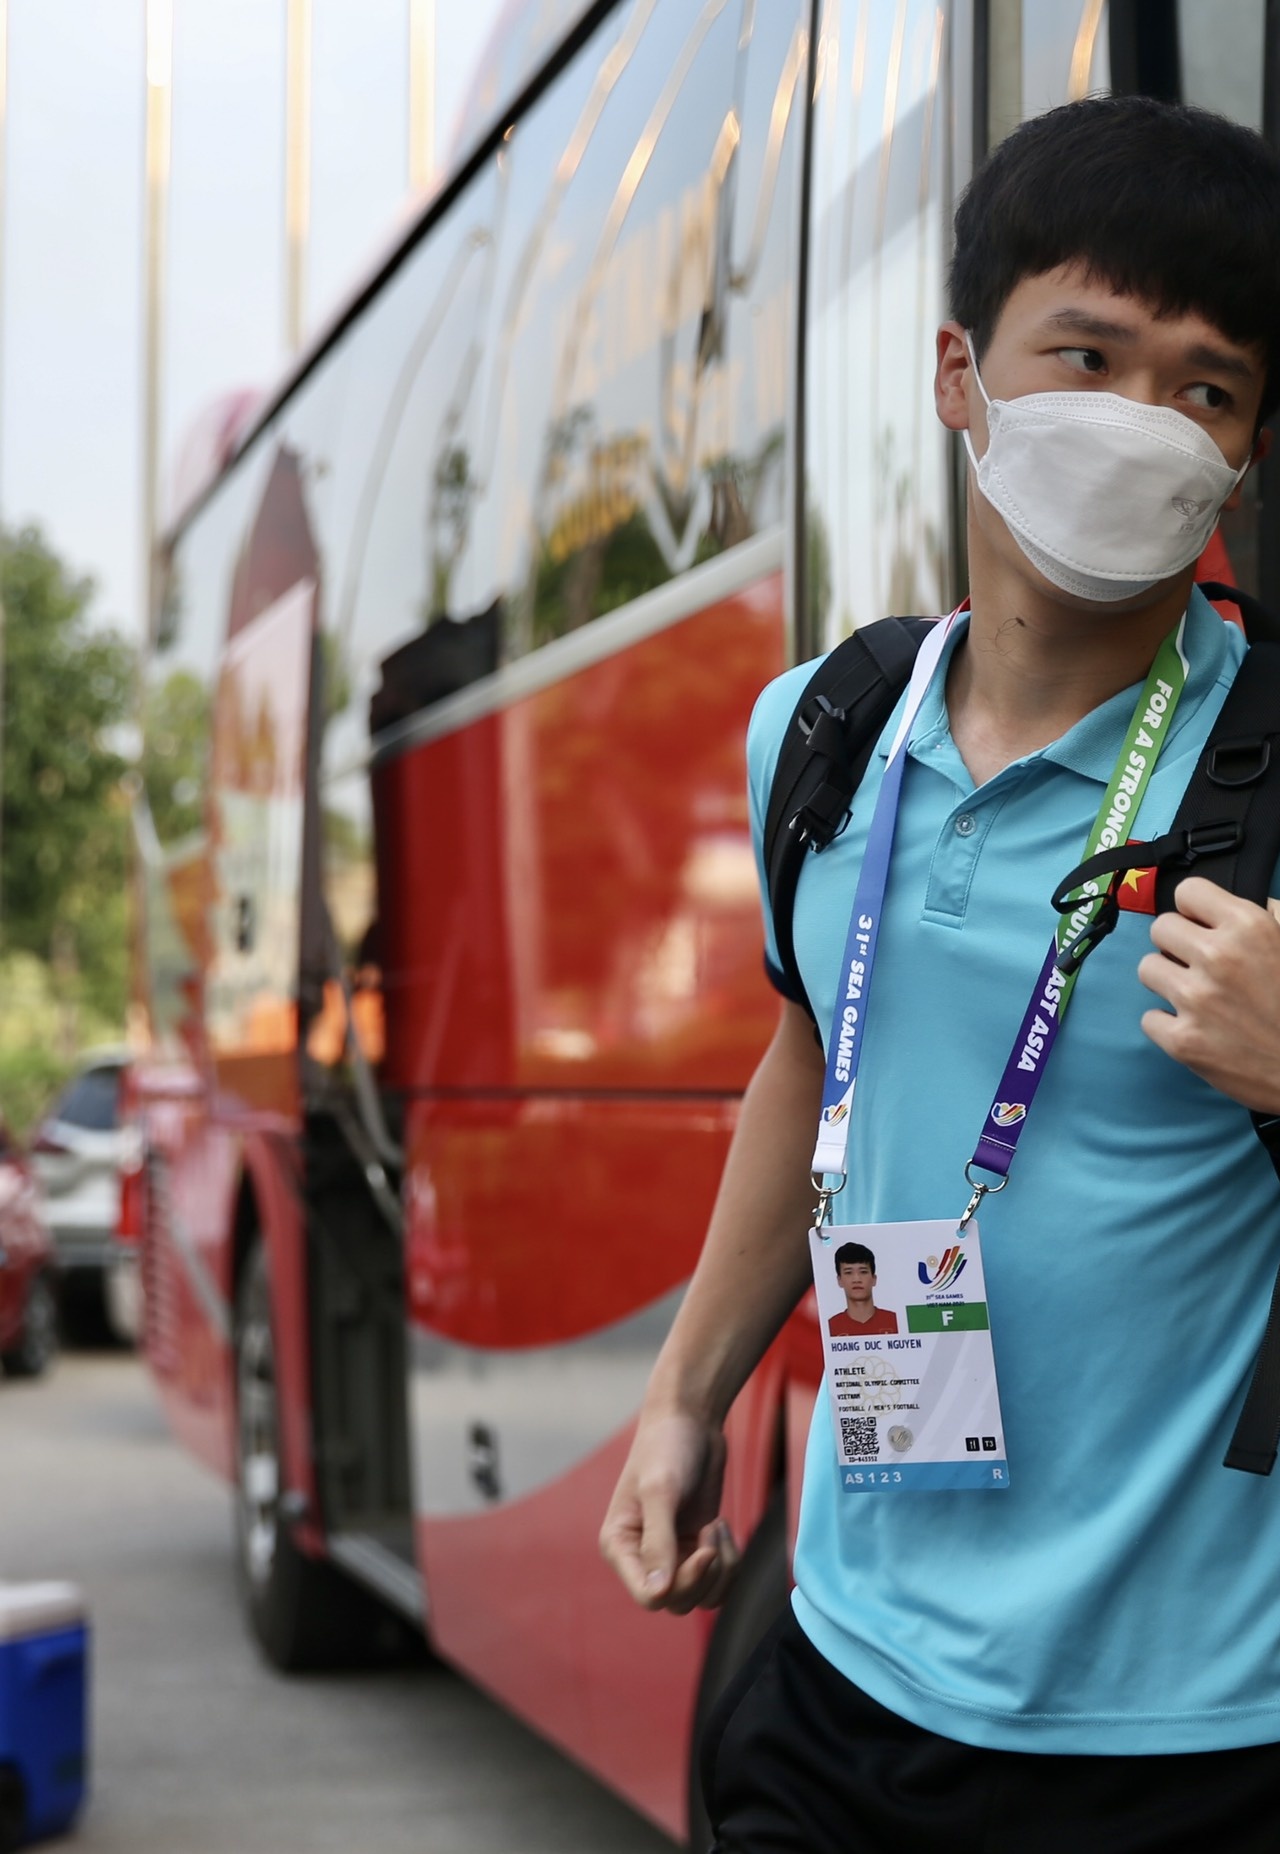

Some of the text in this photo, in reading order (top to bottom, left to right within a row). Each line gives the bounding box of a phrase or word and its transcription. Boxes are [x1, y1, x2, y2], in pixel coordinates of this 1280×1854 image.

[1142, 678, 1174, 730] FOR
[1134, 727, 1154, 749] A
[1094, 750, 1147, 855] STRONG
[845, 959, 866, 1000] SEA
[834, 1005, 859, 1083] GAMES
[1017, 1014, 1050, 1072] ASIA
[942, 1310, 954, 1326] F
[831, 1339, 922, 1352] HOANG DUC NGUYEN
[834, 1367, 866, 1376] ATHLETE
[839, 1404, 865, 1412] FOOTBALL
[845, 1473, 864, 1485] AS
[880, 1472, 890, 1483] 2
[893, 1471, 902, 1482] 3
[992, 1468, 1003, 1480] R
